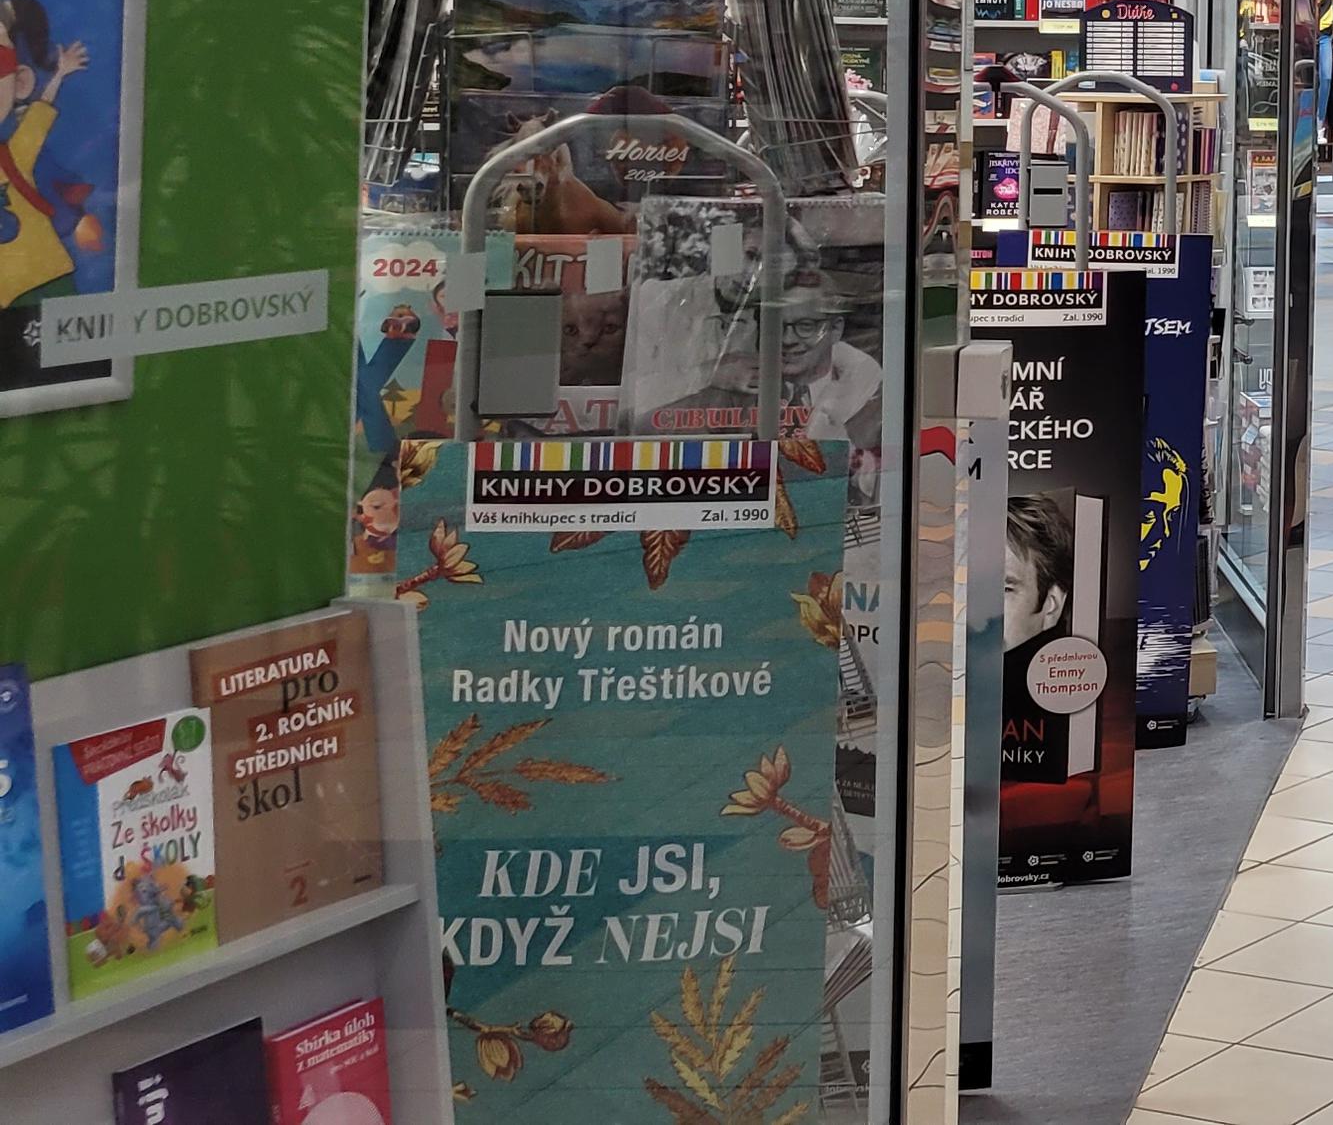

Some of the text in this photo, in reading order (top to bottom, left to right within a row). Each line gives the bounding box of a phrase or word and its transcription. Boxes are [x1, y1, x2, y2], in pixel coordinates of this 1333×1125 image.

[1042, 0, 1053, 10] JO
[606, 139, 690, 163] Horses
[371, 258, 439, 277] 2024
[1158, 266, 1176, 276] 1990
[155, 286, 313, 333] DOBROVSKÝ
[990, 312, 1103, 323] s tradicí Zal. 1990
[992, 290, 1098, 306] DOBROVSKÝ
[481, 471, 761, 497] KNIHY DOBROVSKÝ
[472, 507, 769, 528] Váš knihkupec s tradicí Zal. 1990
[503, 615, 722, 659] Nový román
[1039, 651, 1099, 665] S předmluvou
[220, 647, 331, 696] LITERATURA
[280, 669, 340, 713] pro
[452, 662, 772, 711] Radky Třeštíkové
[1035, 682, 1098, 697] Thompson
[1049, 666, 1086, 680] Emmy
[256, 696, 355, 743] 2. ROČNÍK
[234, 736, 339, 780] STŘEDNÍCH
[236, 767, 304, 822] škol
[111, 820, 136, 850] Ze
[140, 803, 198, 840] školky
[140, 831, 202, 873] ŠKOLY
[477, 841, 721, 900] KDE JSI,
[289, 876, 308, 909] 2
[440, 905, 771, 967] KDYŽ NEJSI
[294, 1028, 342, 1060] Sbírka
[344, 1011, 376, 1038] úloh
[296, 1060, 305, 1074] z
[306, 1027, 376, 1070] matematiky
